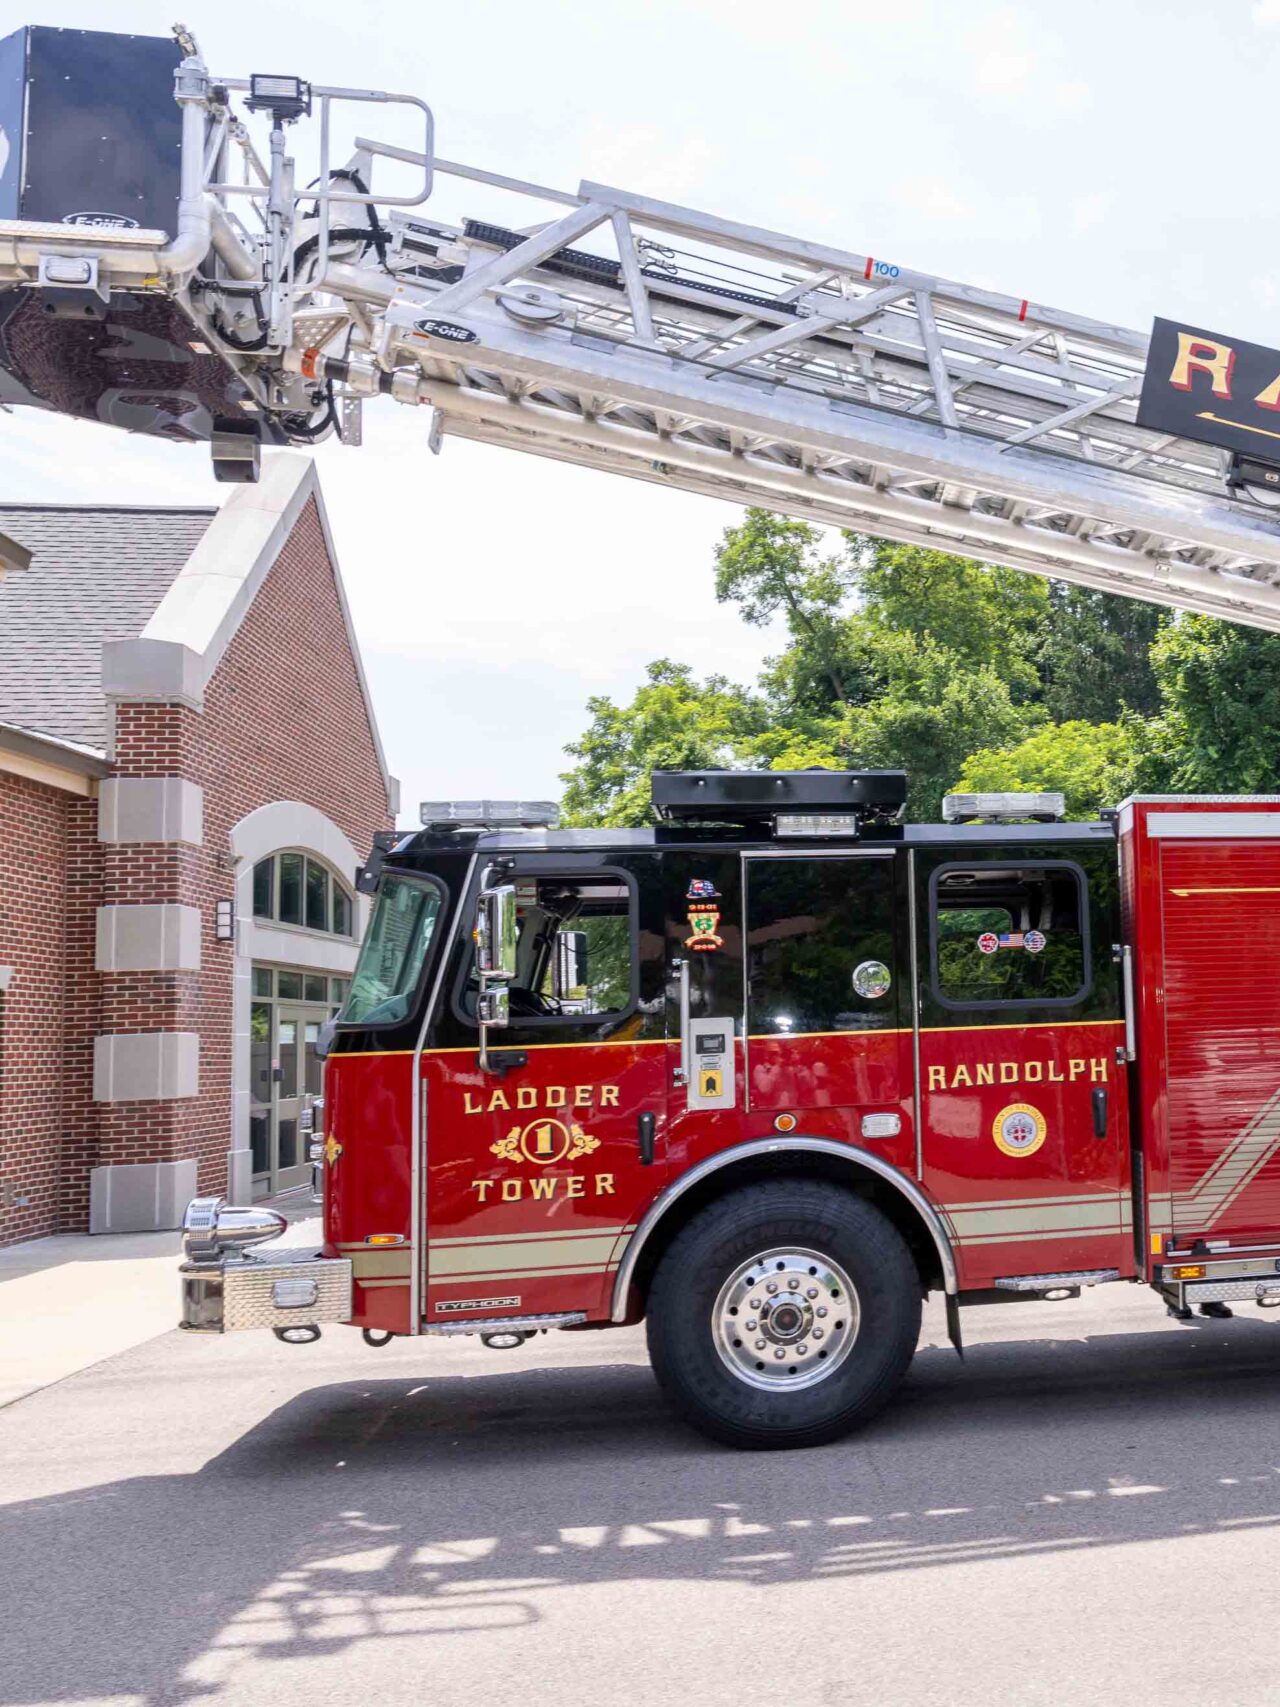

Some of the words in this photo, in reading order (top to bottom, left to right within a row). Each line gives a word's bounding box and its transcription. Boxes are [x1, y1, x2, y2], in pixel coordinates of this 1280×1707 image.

[874, 262, 900, 278] 100
[423, 322, 470, 340] E-ONE
[927, 1057, 1108, 1092] RANDOLPH
[464, 1085, 621, 1115] LADDER
[534, 1123, 555, 1156] 1
[471, 1173, 616, 1203] TOWER
[438, 1298, 519, 1310] TYPHOON
